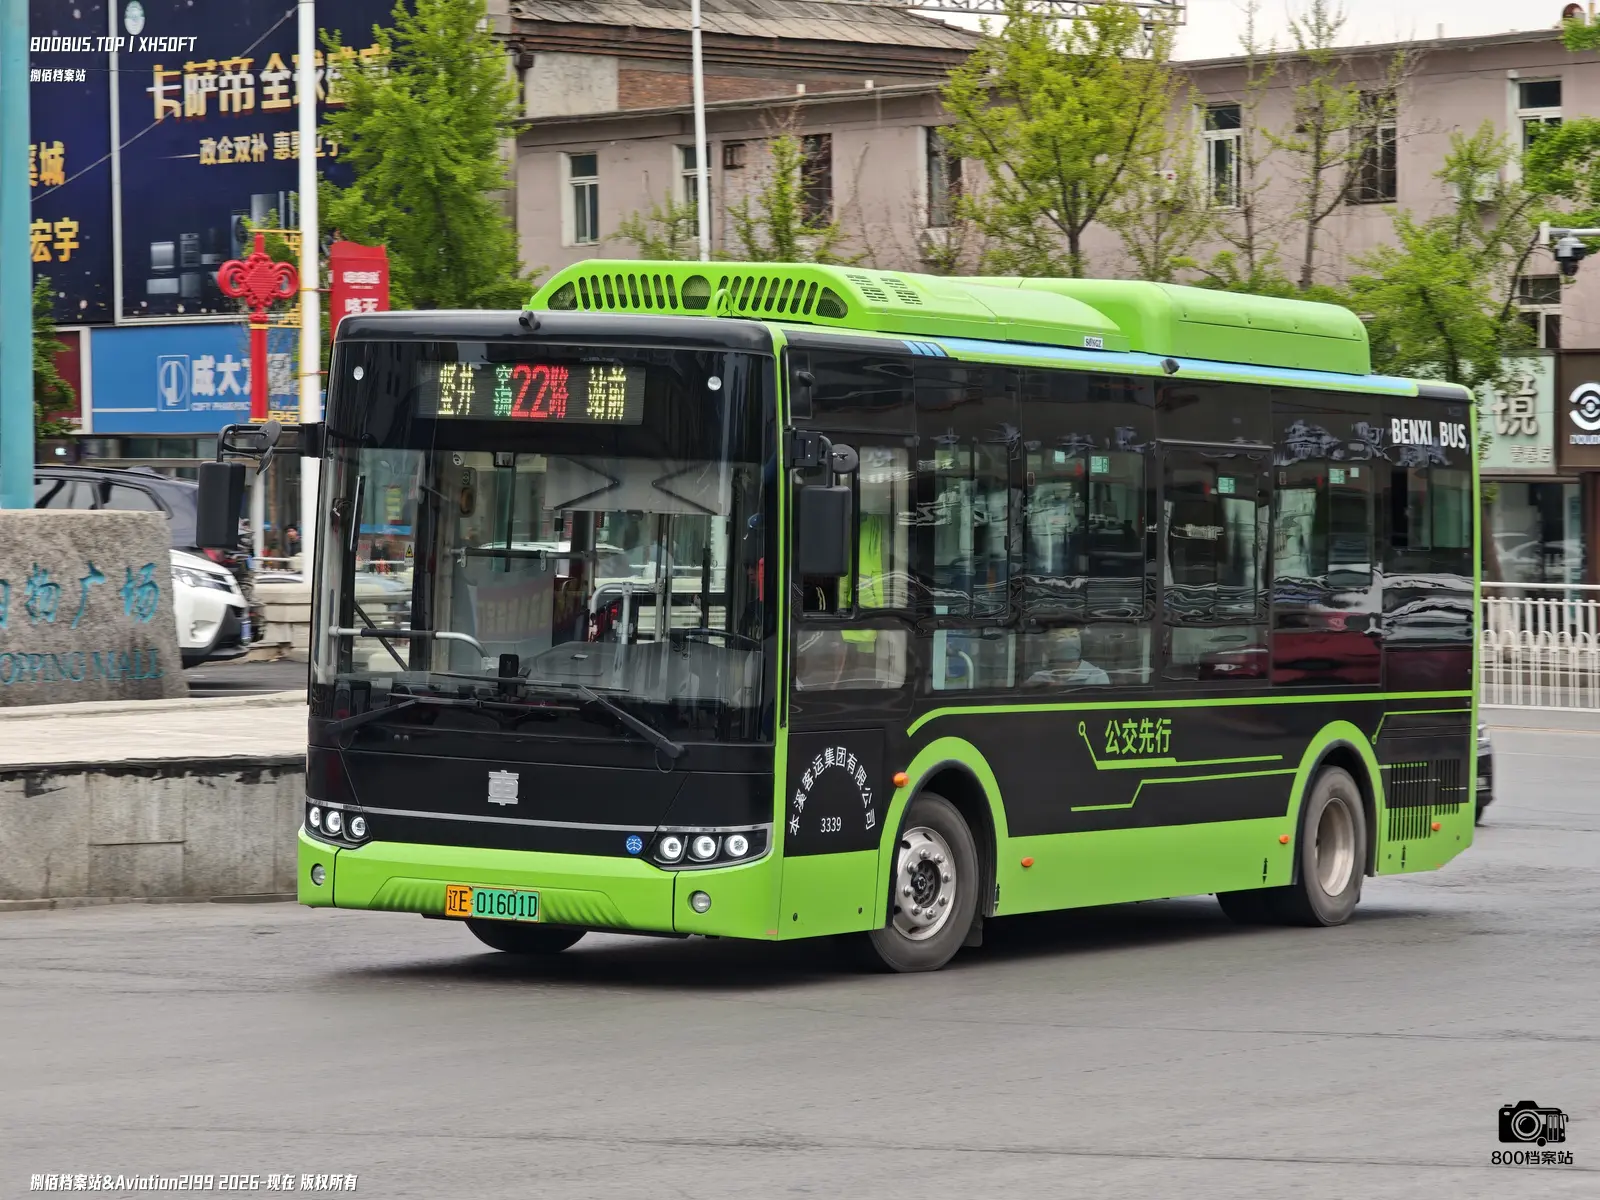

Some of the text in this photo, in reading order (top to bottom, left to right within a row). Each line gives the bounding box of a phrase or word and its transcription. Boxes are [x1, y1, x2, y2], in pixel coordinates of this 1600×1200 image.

[199, 132, 268, 165] 政企双补
[1391, 417, 1468, 449] BENXI BUS
[1105, 717, 1172, 755] 公交先行
[789, 746, 876, 836] 本溪客运集团有限公司
[820, 817, 842, 833] 3339
[448, 889, 538, 918] 辽E 01601D
